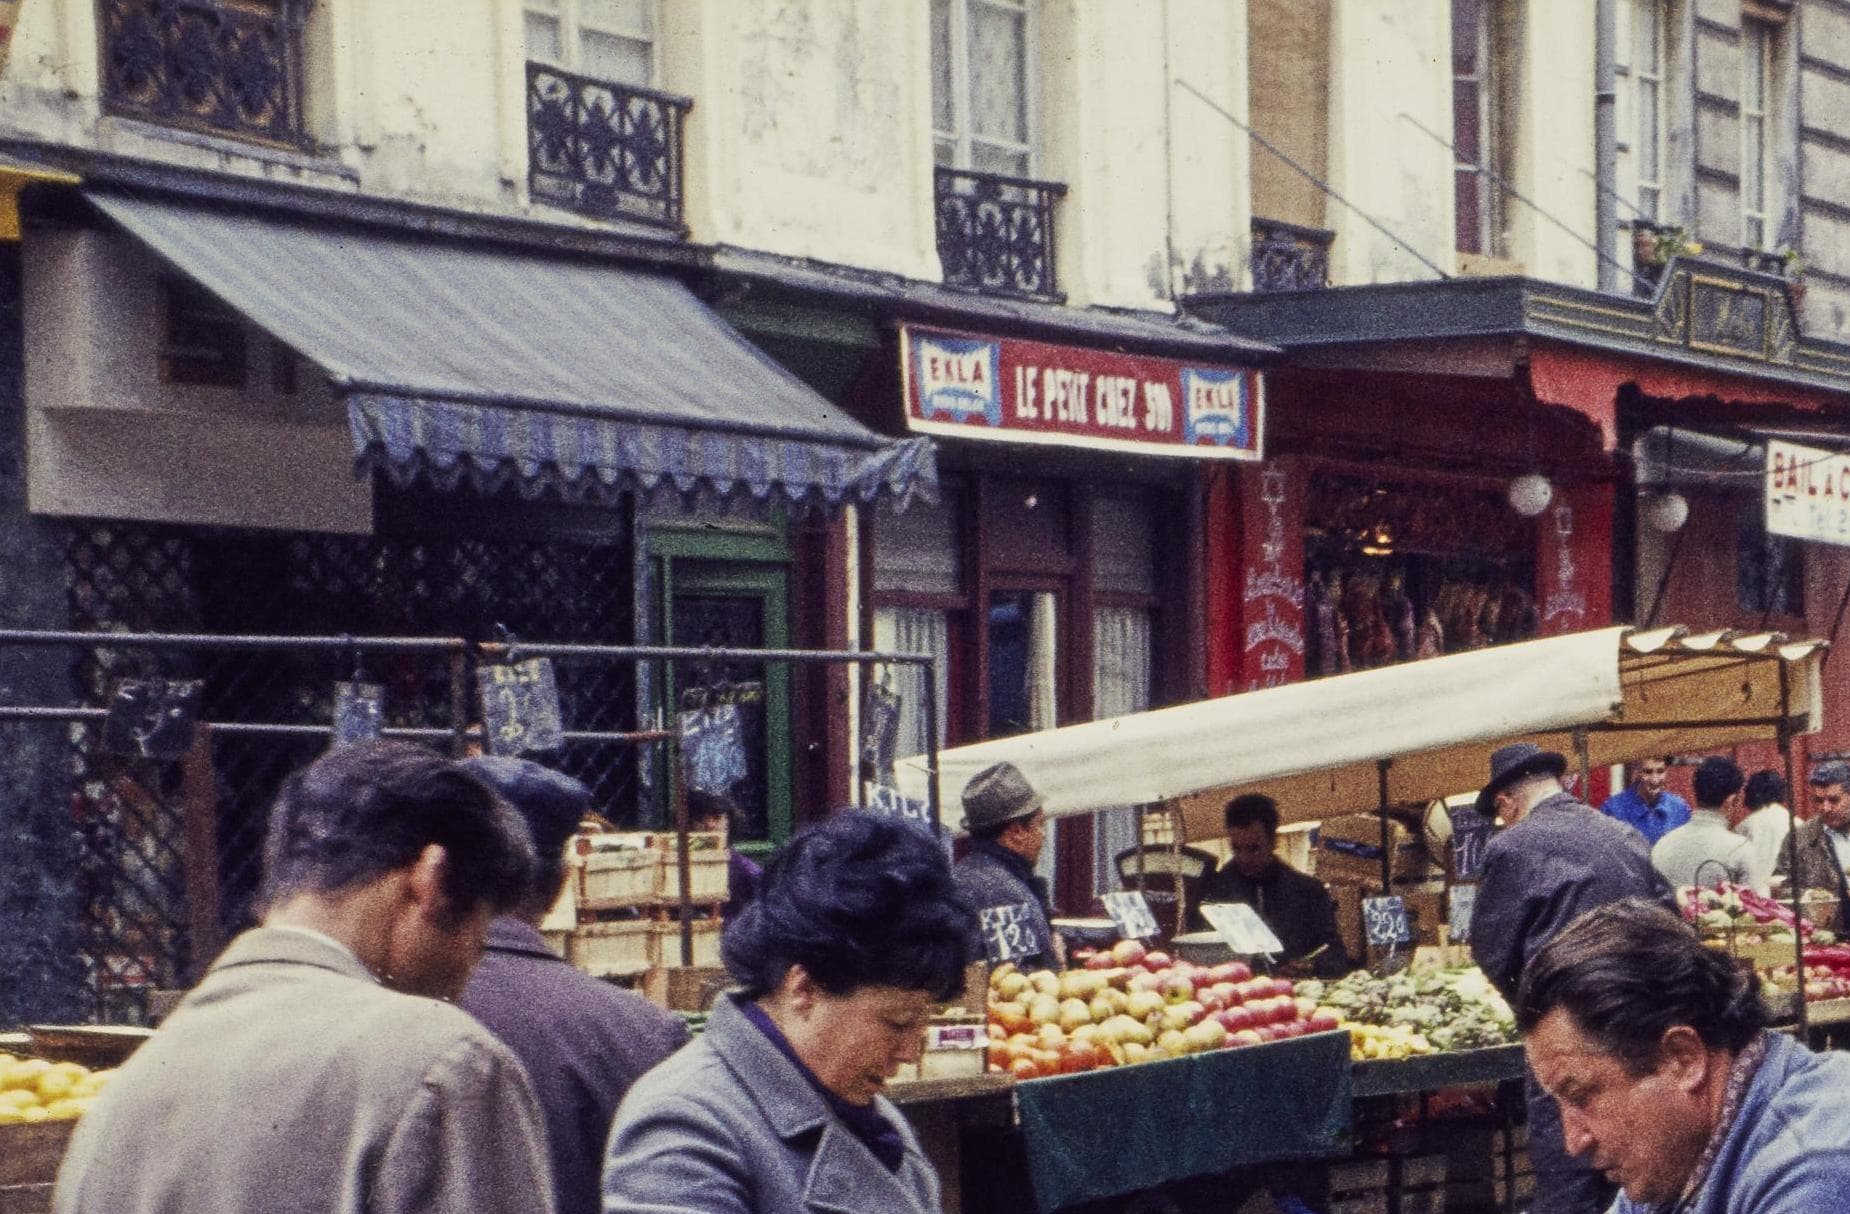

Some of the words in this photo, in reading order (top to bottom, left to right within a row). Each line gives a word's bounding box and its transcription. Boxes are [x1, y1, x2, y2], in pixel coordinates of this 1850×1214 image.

[930, 356, 985, 384] EKLA
[1015, 366, 1038, 418] LE
[1043, 367, 1090, 424] PETIT
[1096, 374, 1137, 429] CHEZ
